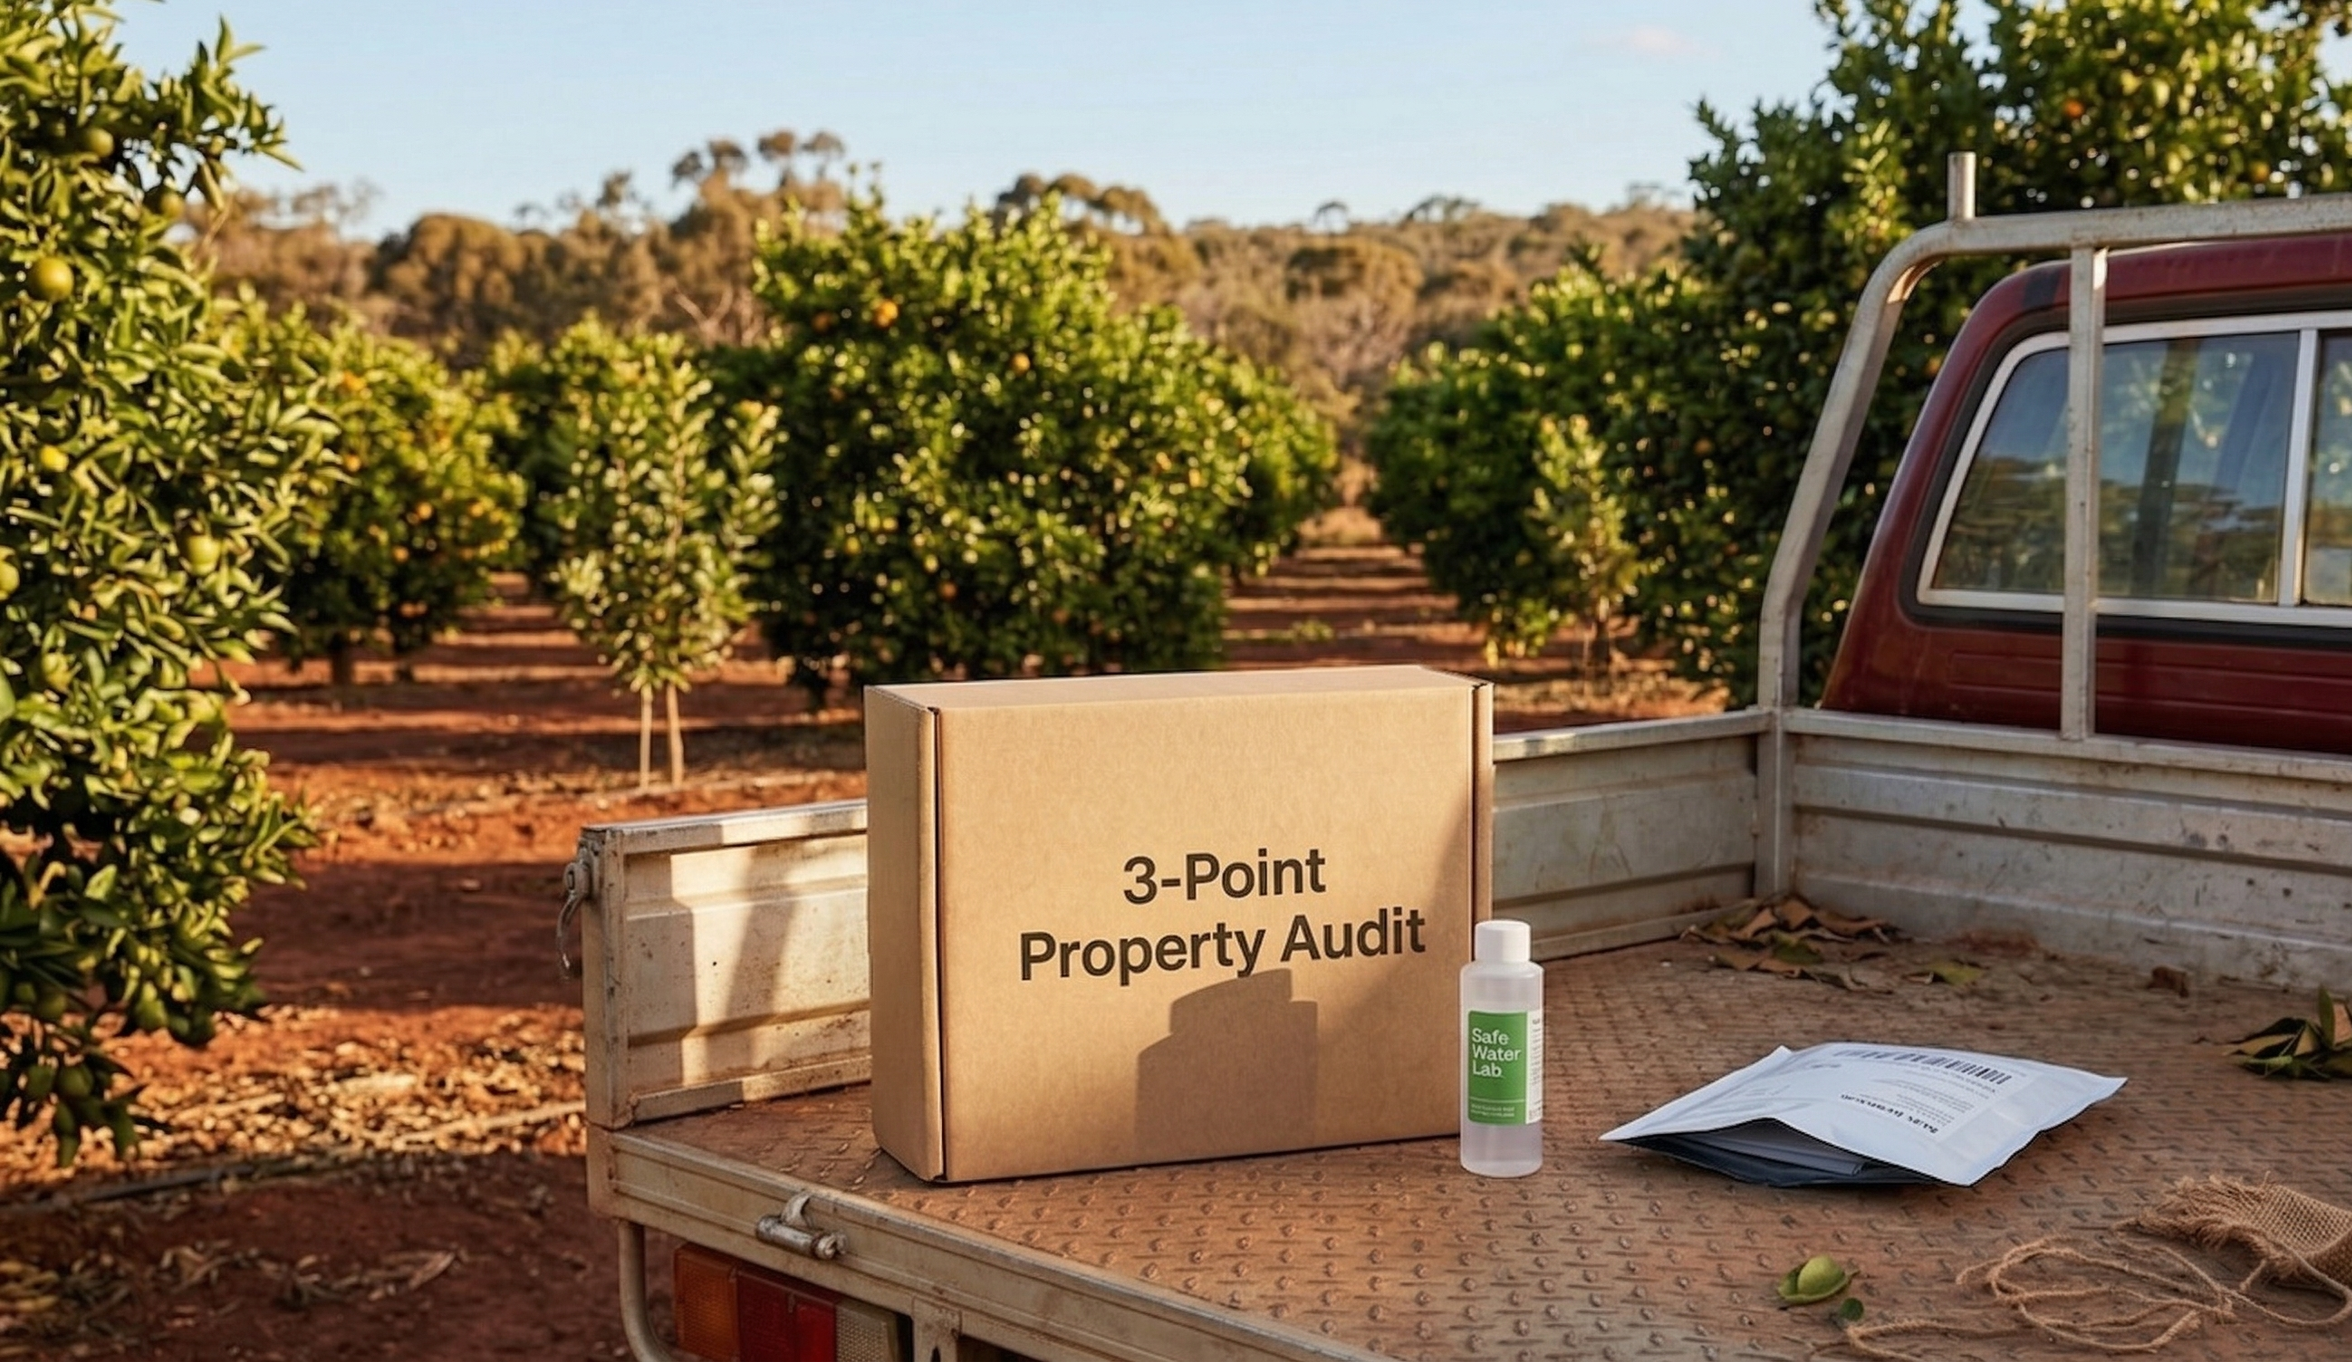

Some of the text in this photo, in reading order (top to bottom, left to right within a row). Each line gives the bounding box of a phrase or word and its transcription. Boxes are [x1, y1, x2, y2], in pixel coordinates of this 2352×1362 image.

[1124, 847, 1326, 905] 3-Point
[1021, 906, 1427, 987] Property Audit
[1472, 1028, 1509, 1045] Safe
[1472, 1044, 1521, 1061] Water
[1473, 1060, 1502, 1078] Lab
